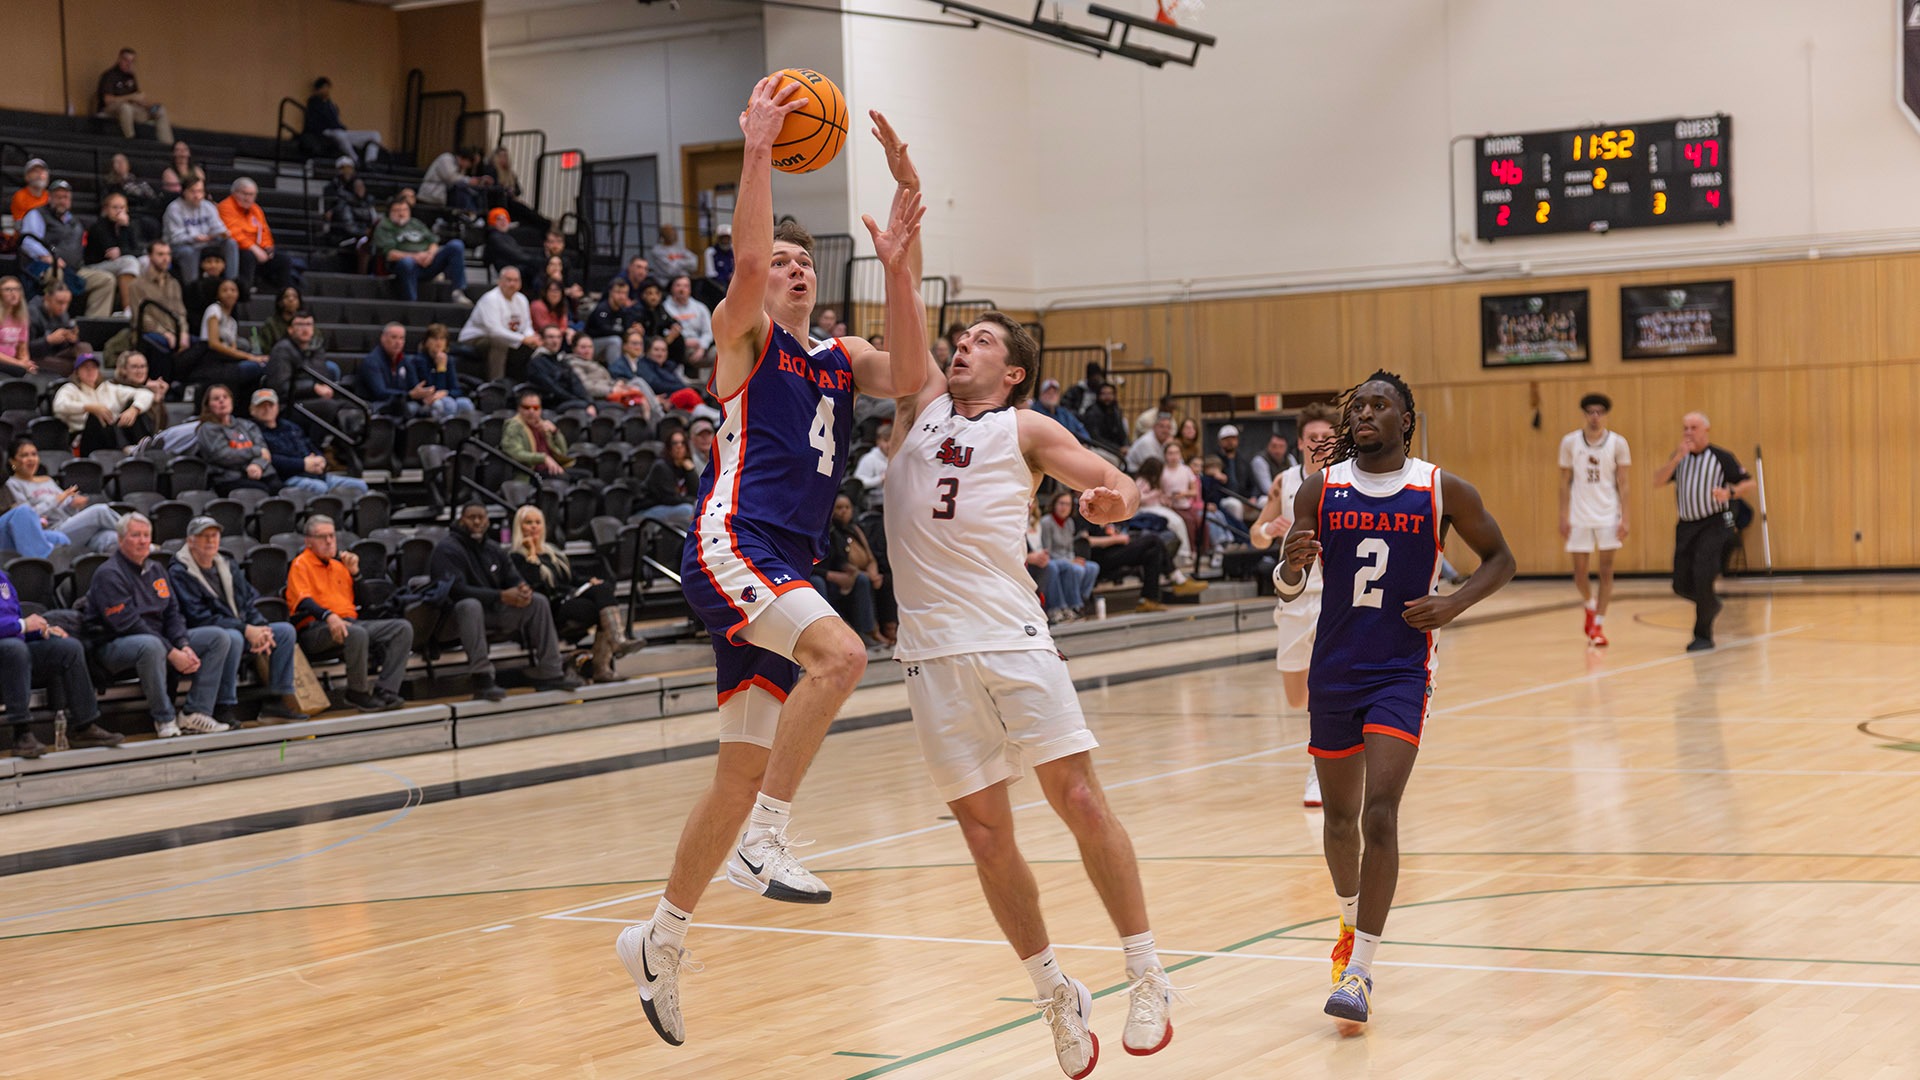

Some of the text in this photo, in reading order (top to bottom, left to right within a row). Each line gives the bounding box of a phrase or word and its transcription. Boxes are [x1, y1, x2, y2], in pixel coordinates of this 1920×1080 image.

[1675, 118, 1720, 139] GUEST
[1573, 129, 1635, 161] 11:52
[1684, 140, 1719, 168] 47
[1490, 159, 1523, 185] 46
[1592, 167, 1608, 190] 2
[1652, 192, 1667, 215] 3
[1705, 189, 1720, 208] 4
[1496, 204, 1511, 226] 2
[1535, 201, 1550, 223] 2
[808, 394, 836, 477] 4
[932, 477, 960, 520] 3
[1328, 511, 1425, 534] HOBART
[1352, 537, 1390, 609] 2
